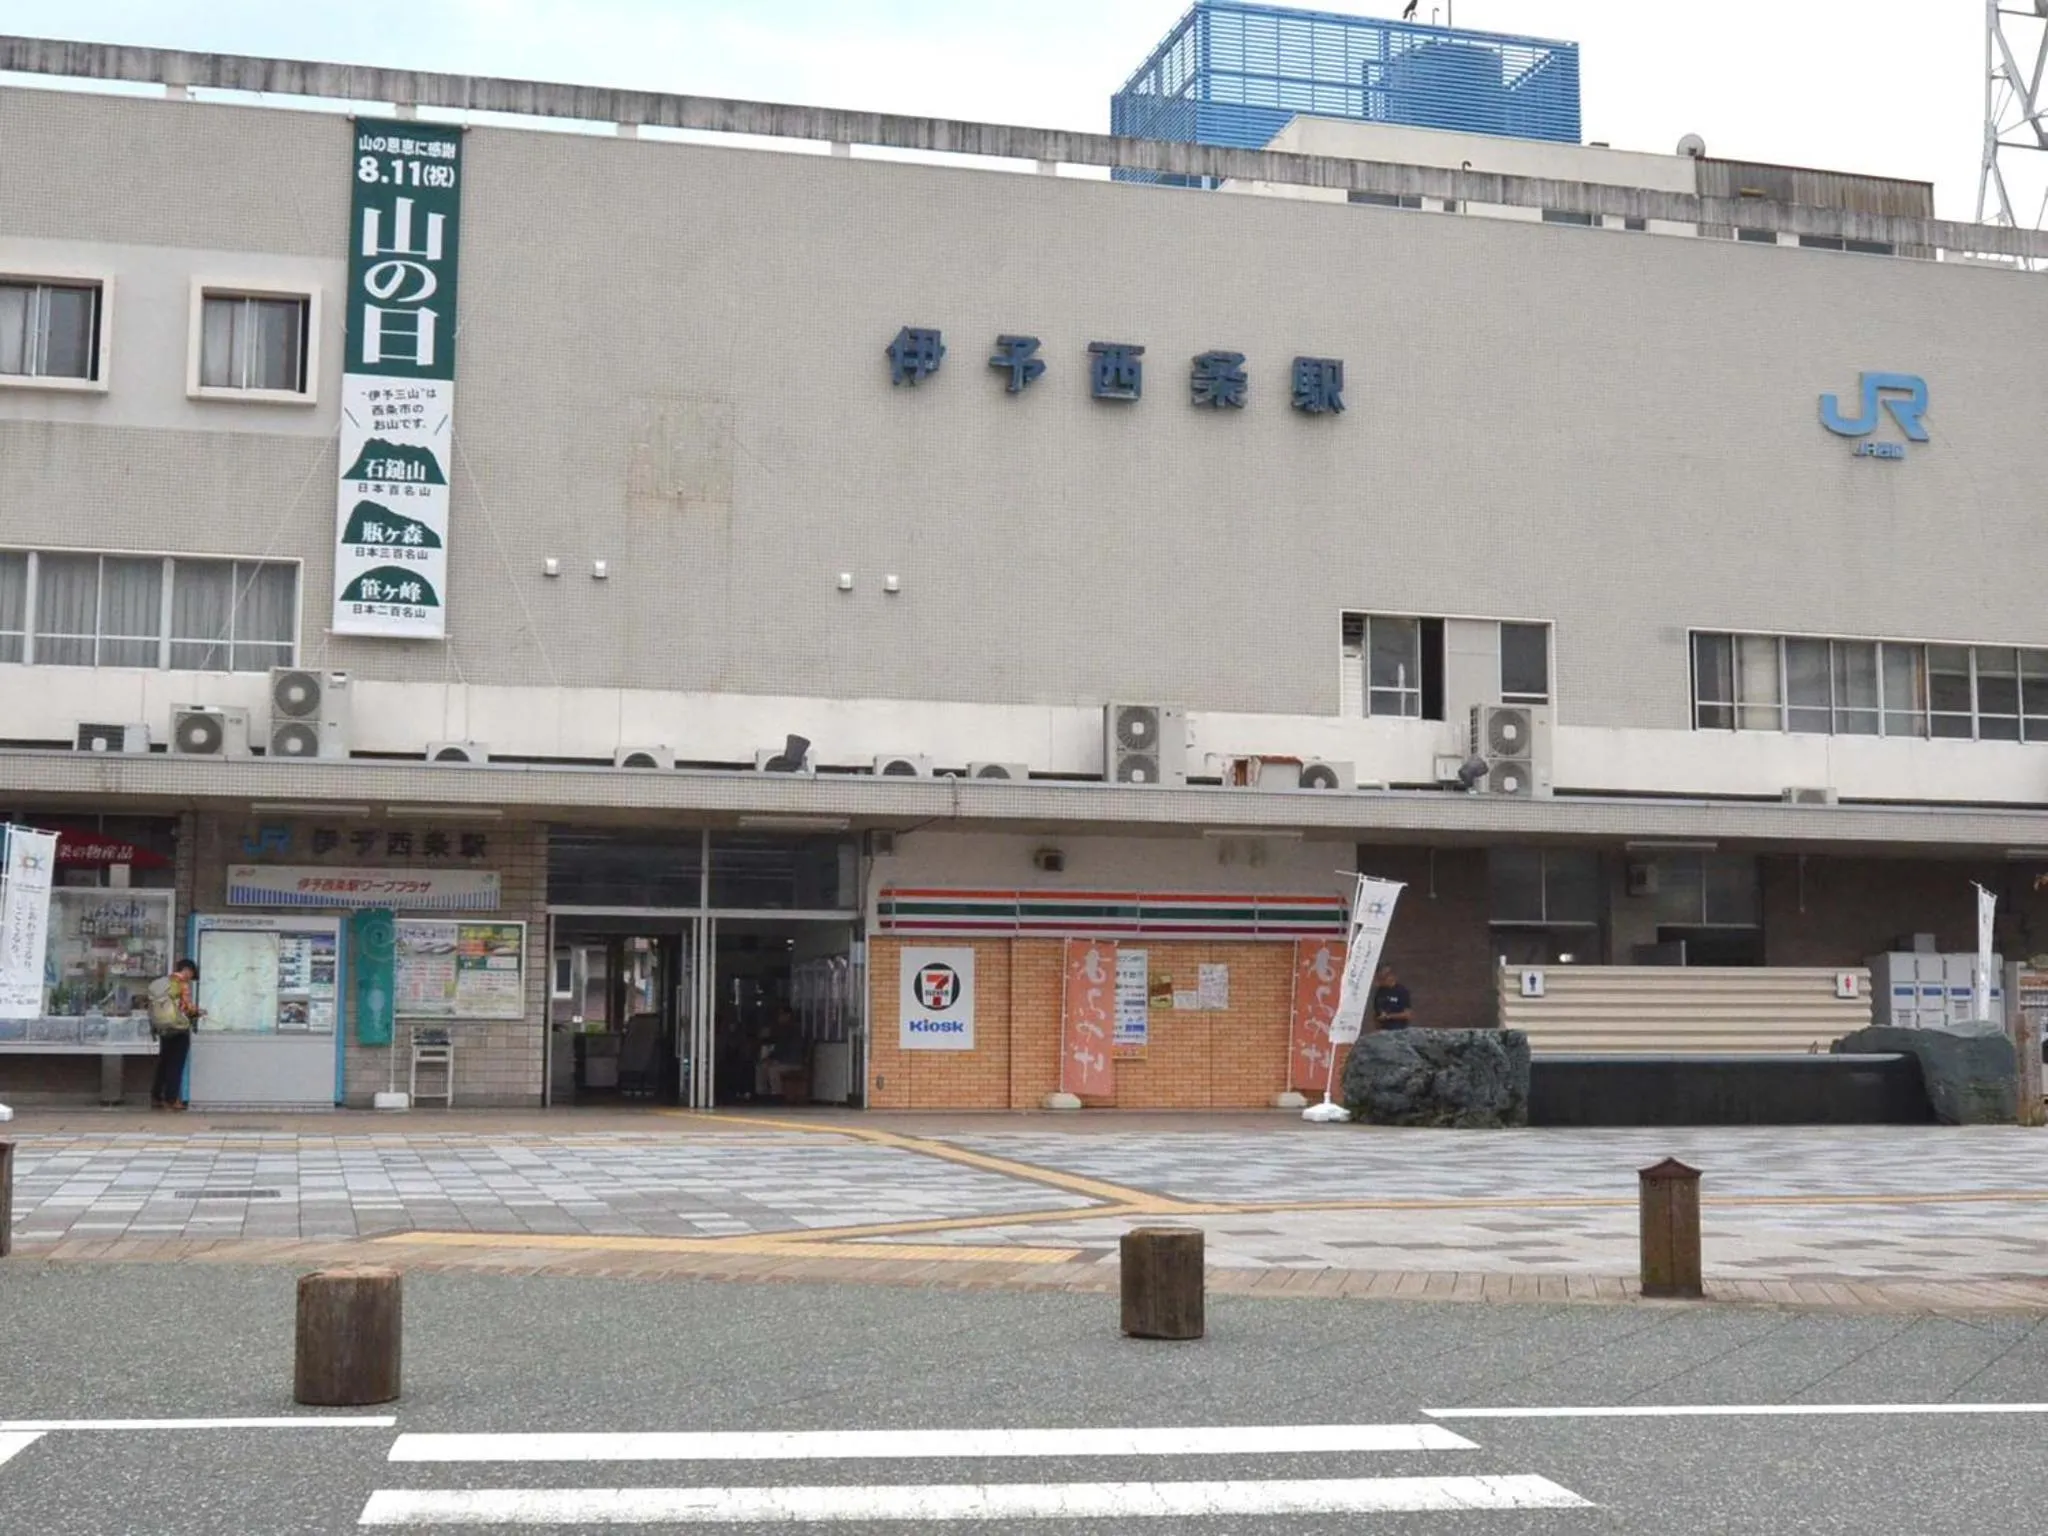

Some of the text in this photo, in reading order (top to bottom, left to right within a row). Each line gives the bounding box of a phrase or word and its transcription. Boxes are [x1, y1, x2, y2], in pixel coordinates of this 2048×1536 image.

[359, 134, 456, 159] 山の恩恵に感謝
[358, 155, 456, 188] 8.11(祝)
[361, 197, 447, 366] 山の日
[885, 325, 1345, 414] 伊予西条駅
[371, 403, 424, 416] 西条市の
[1818, 371, 1930, 443] JR
[364, 458, 427, 481] 石鎚山
[357, 482, 432, 497] 日本百名山
[354, 546, 429, 561] 日本三百名山
[353, 603, 426, 619] 日本二百名山
[909, 1019, 964, 1033] Kiosk
